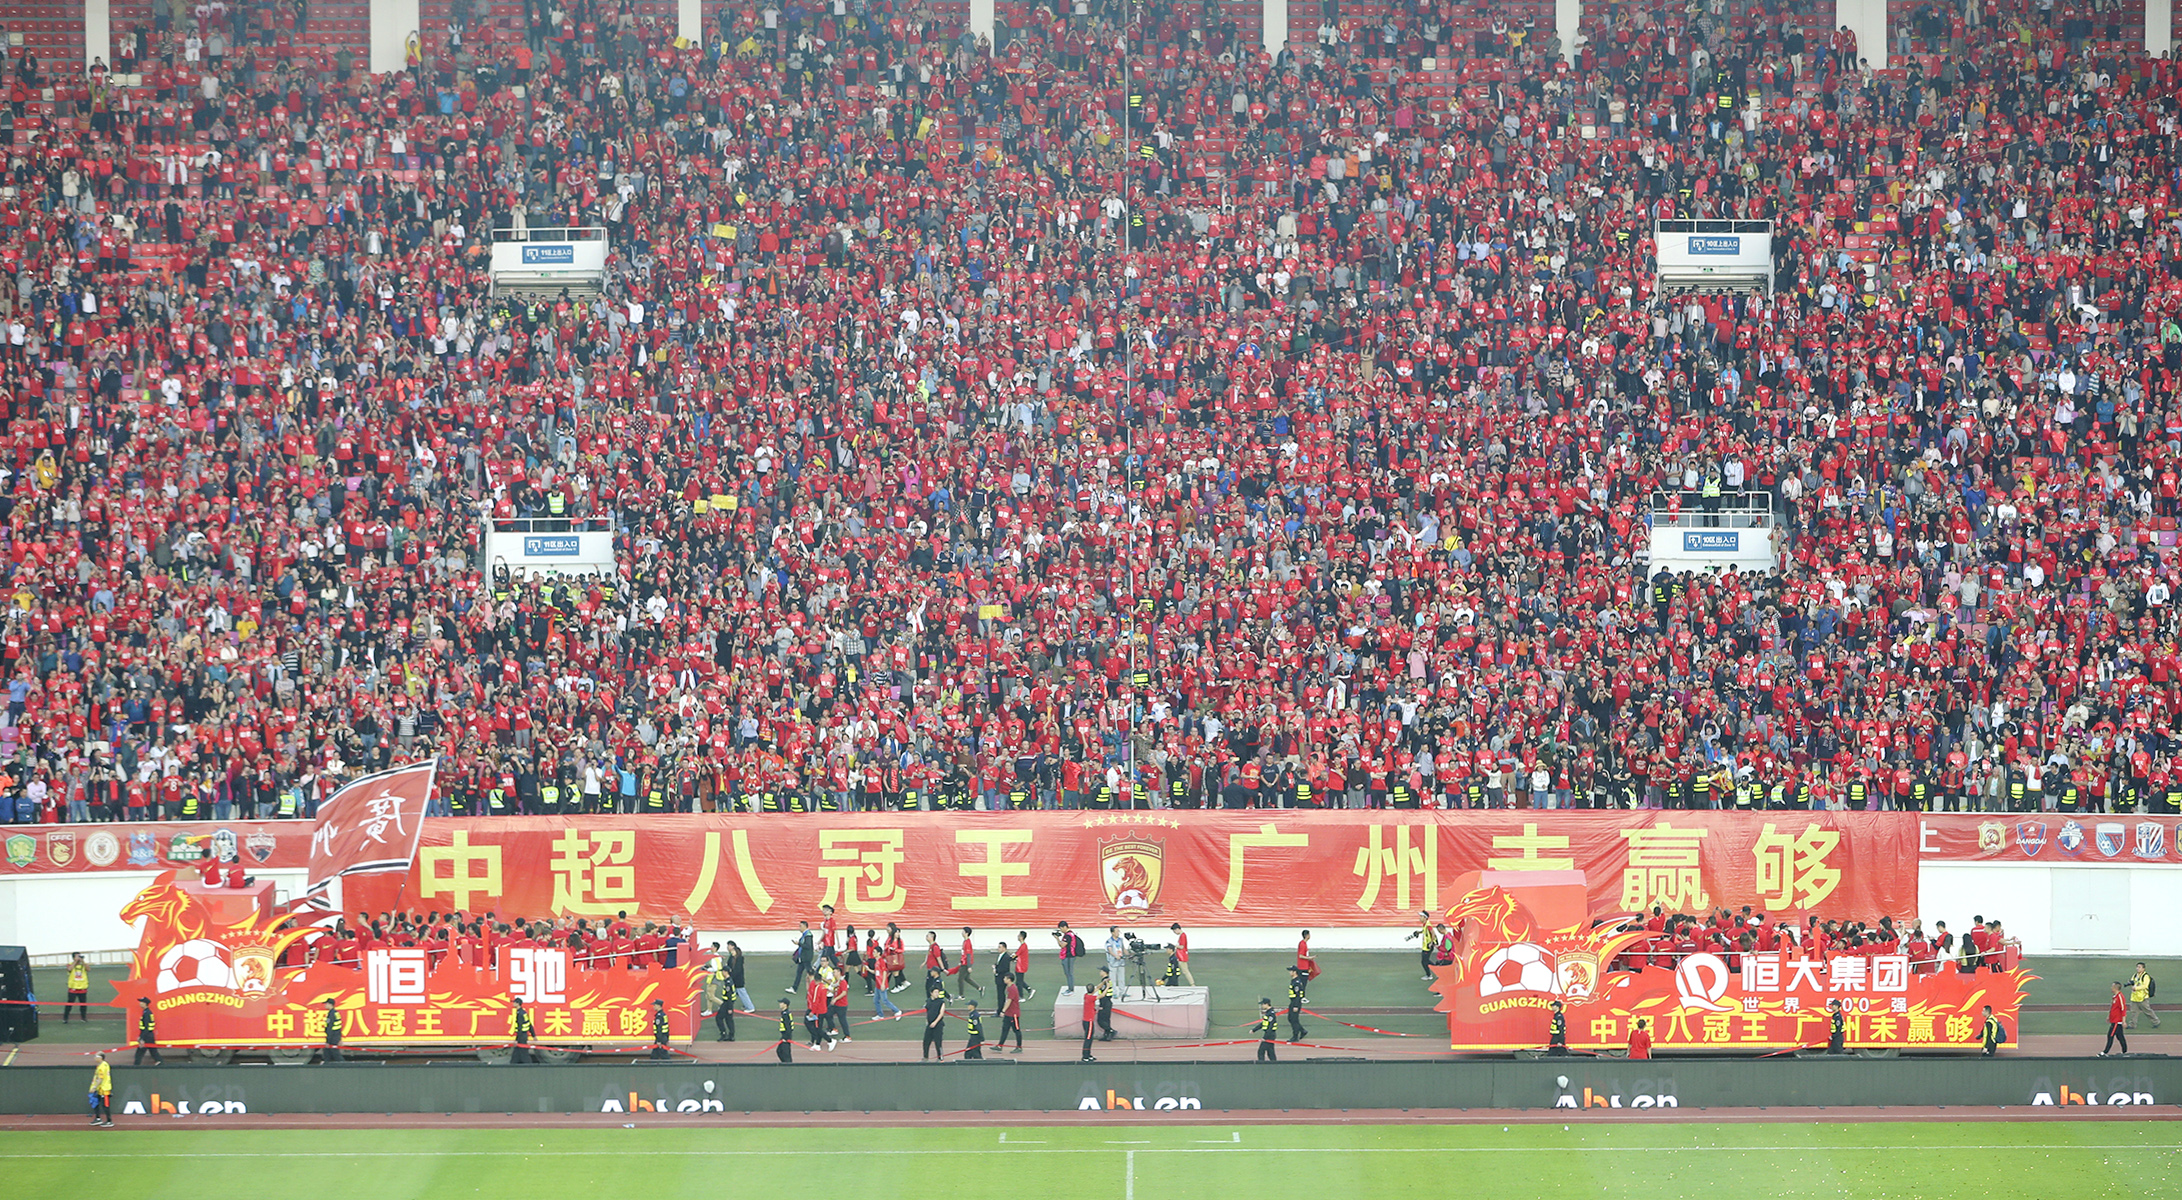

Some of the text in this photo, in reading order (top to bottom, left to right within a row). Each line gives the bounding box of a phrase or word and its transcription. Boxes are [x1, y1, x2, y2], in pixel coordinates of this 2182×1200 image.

[543, 540, 577, 548] 11区出入口
[420, 828, 1038, 917] 中超八冠王
[367, 948, 566, 1004] 恒驰
[1741, 955, 1909, 992] 恒大集团
[157, 992, 245, 1011] GUANGZHOU
[267, 1008, 443, 1038] 中超八冠王
